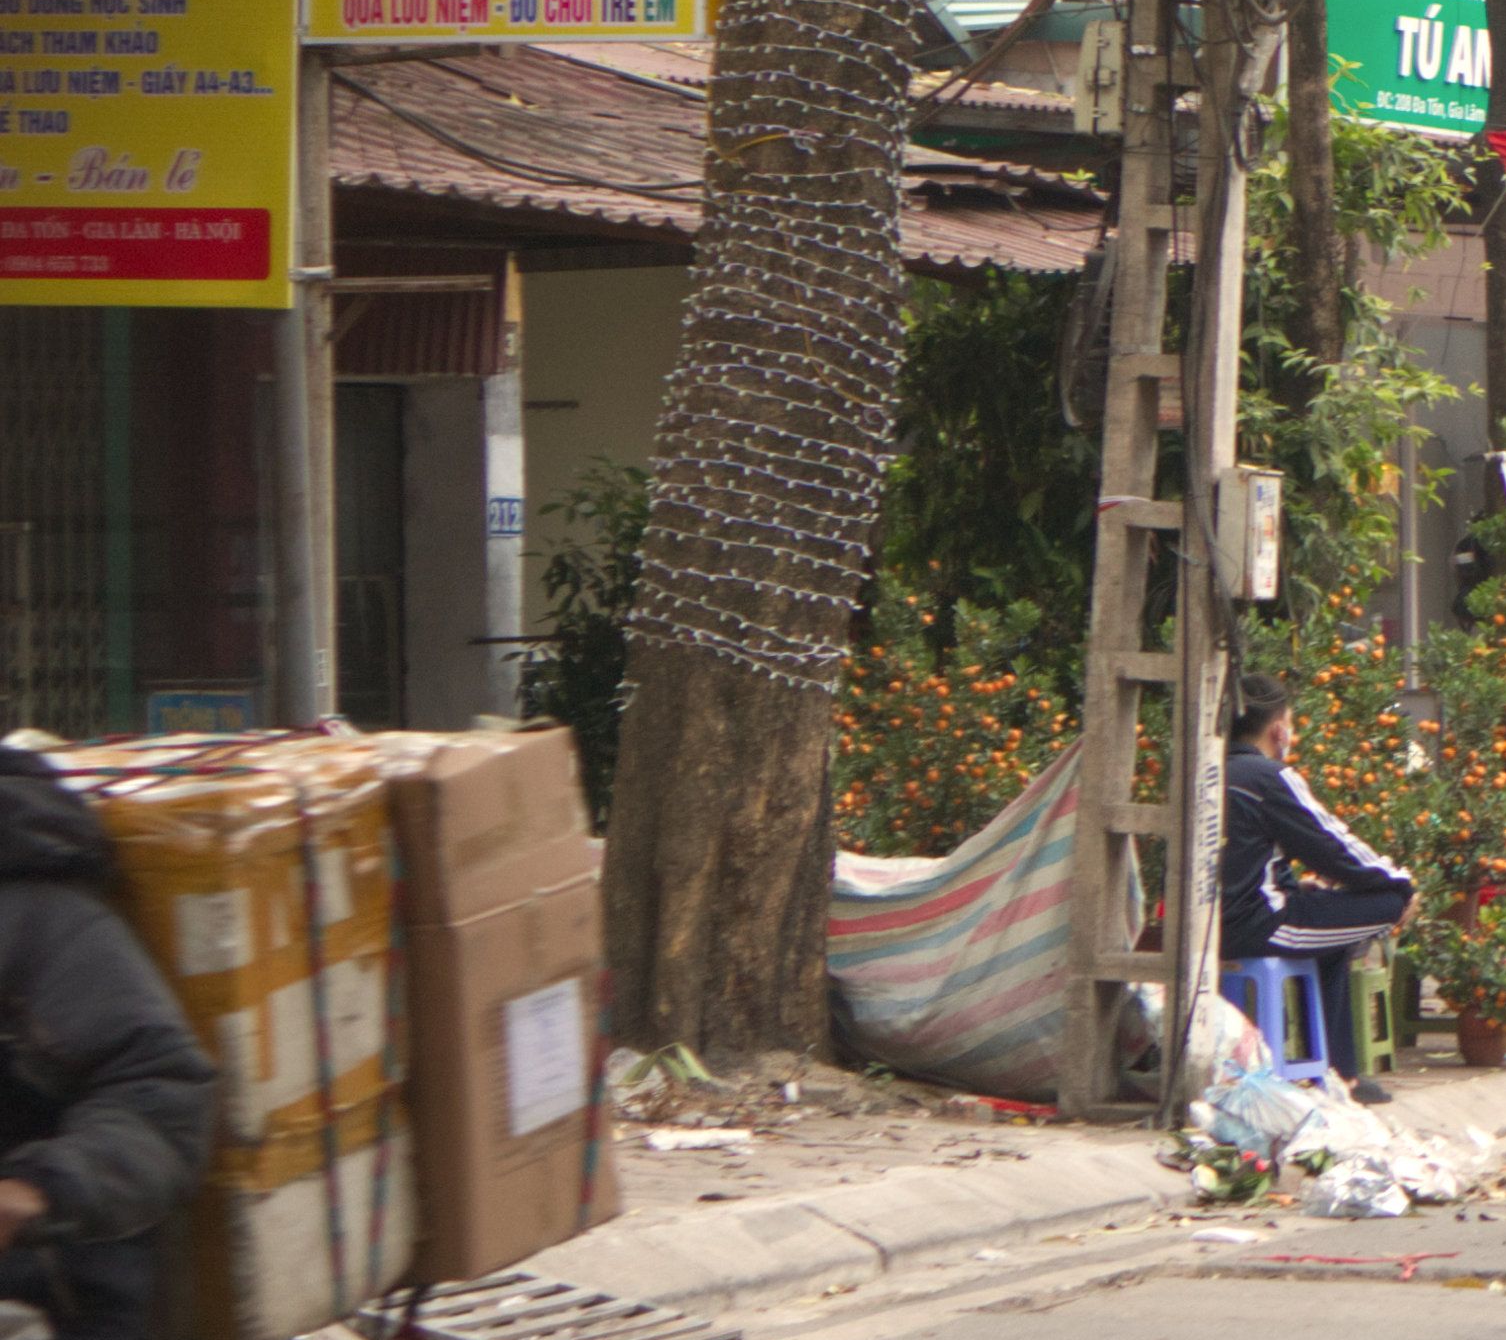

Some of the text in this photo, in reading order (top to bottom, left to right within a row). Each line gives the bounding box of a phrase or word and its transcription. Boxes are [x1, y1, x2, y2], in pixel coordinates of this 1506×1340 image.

[42, 20, 159, 54] THAM KHẢO
[1396, 3, 1445, 80] TÚ
[19, 110, 69, 133] THAO
